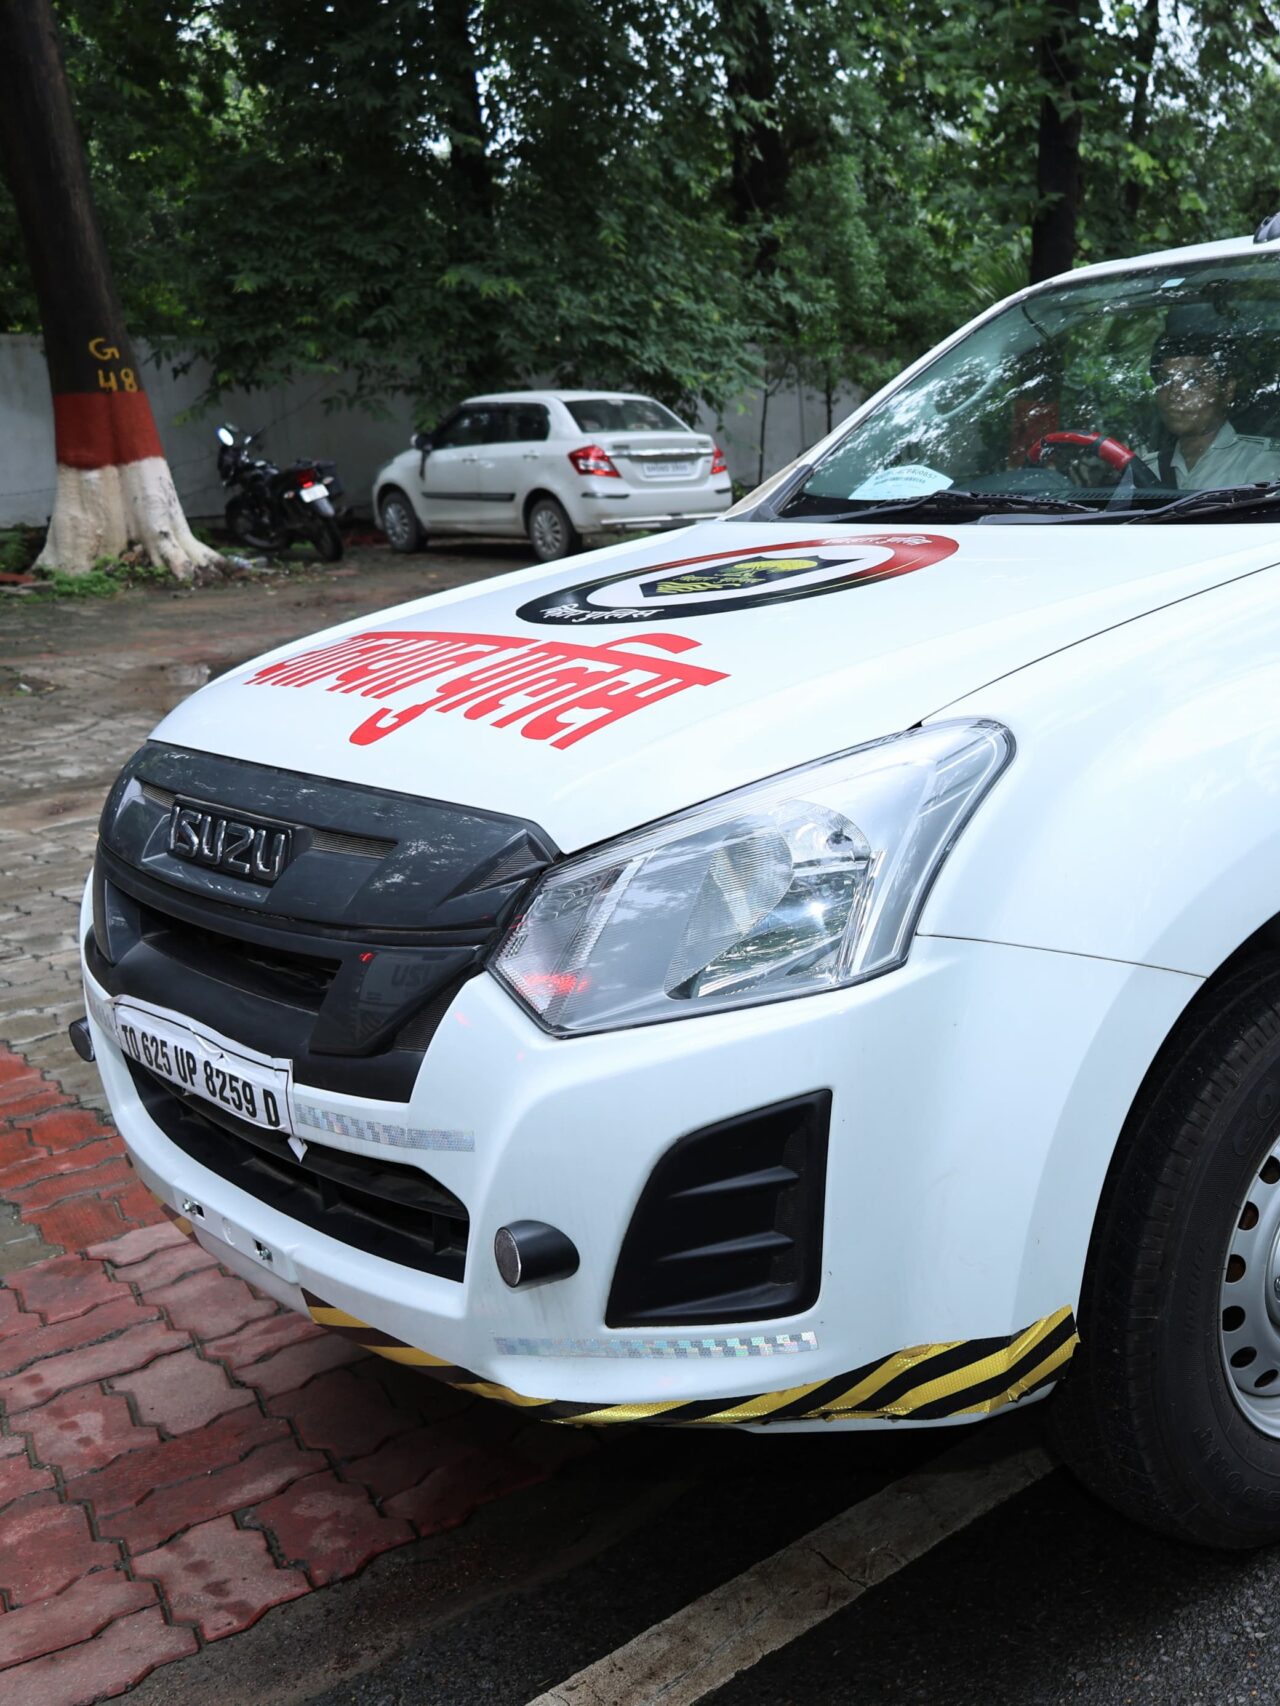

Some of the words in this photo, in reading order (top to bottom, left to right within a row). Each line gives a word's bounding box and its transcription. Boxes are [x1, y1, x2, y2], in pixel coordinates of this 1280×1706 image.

[88, 338, 119, 360] G
[98, 367, 138, 393] 48
[348, 632, 732, 751] पुलिस
[170, 805, 287, 881] ISUZU
[141, 1031, 173, 1077] 625
[174, 1045, 197, 1088] UP
[204, 1060, 258, 1119] 8259
[263, 1088, 281, 1128] D
